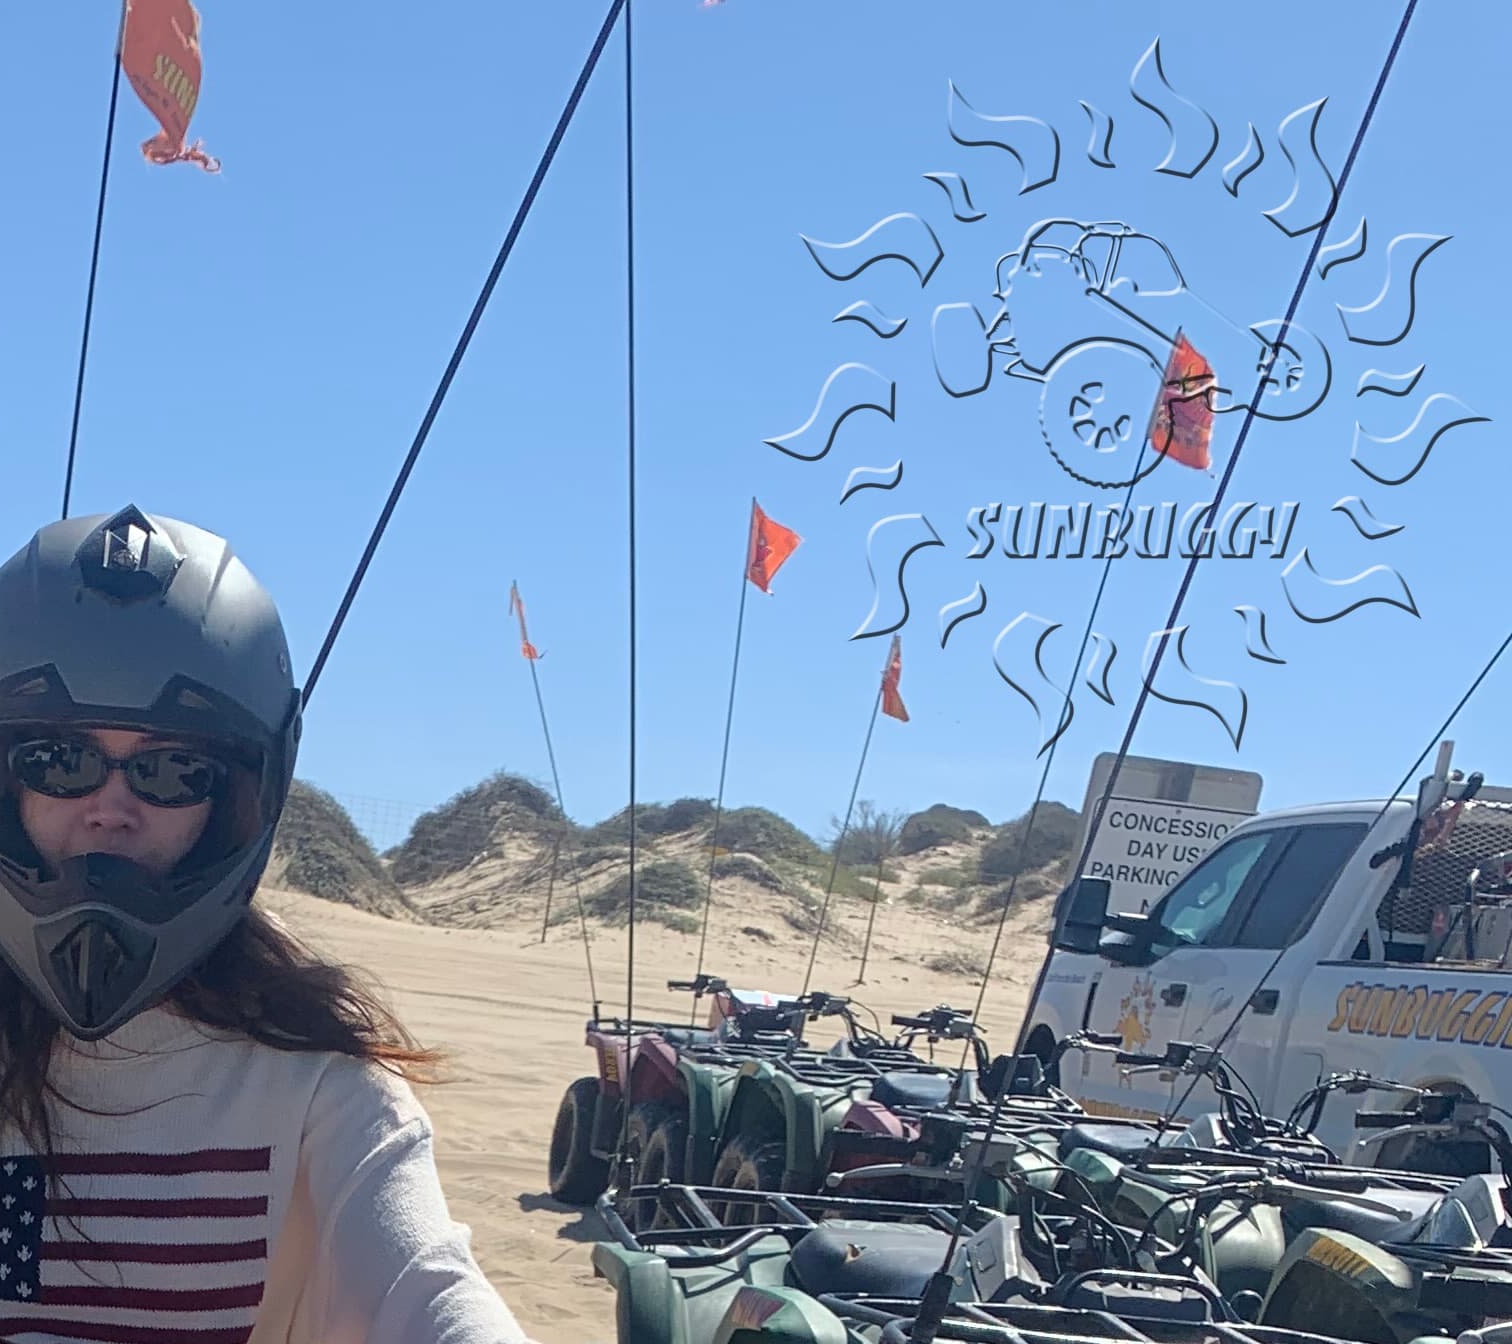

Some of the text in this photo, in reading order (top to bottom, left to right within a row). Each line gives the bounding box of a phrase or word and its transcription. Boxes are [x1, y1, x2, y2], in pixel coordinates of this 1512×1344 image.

[1110, 811, 1235, 841] CONCESSIO
[1127, 840, 1207, 864] DAY US
[1090, 861, 1180, 886] PARKING
